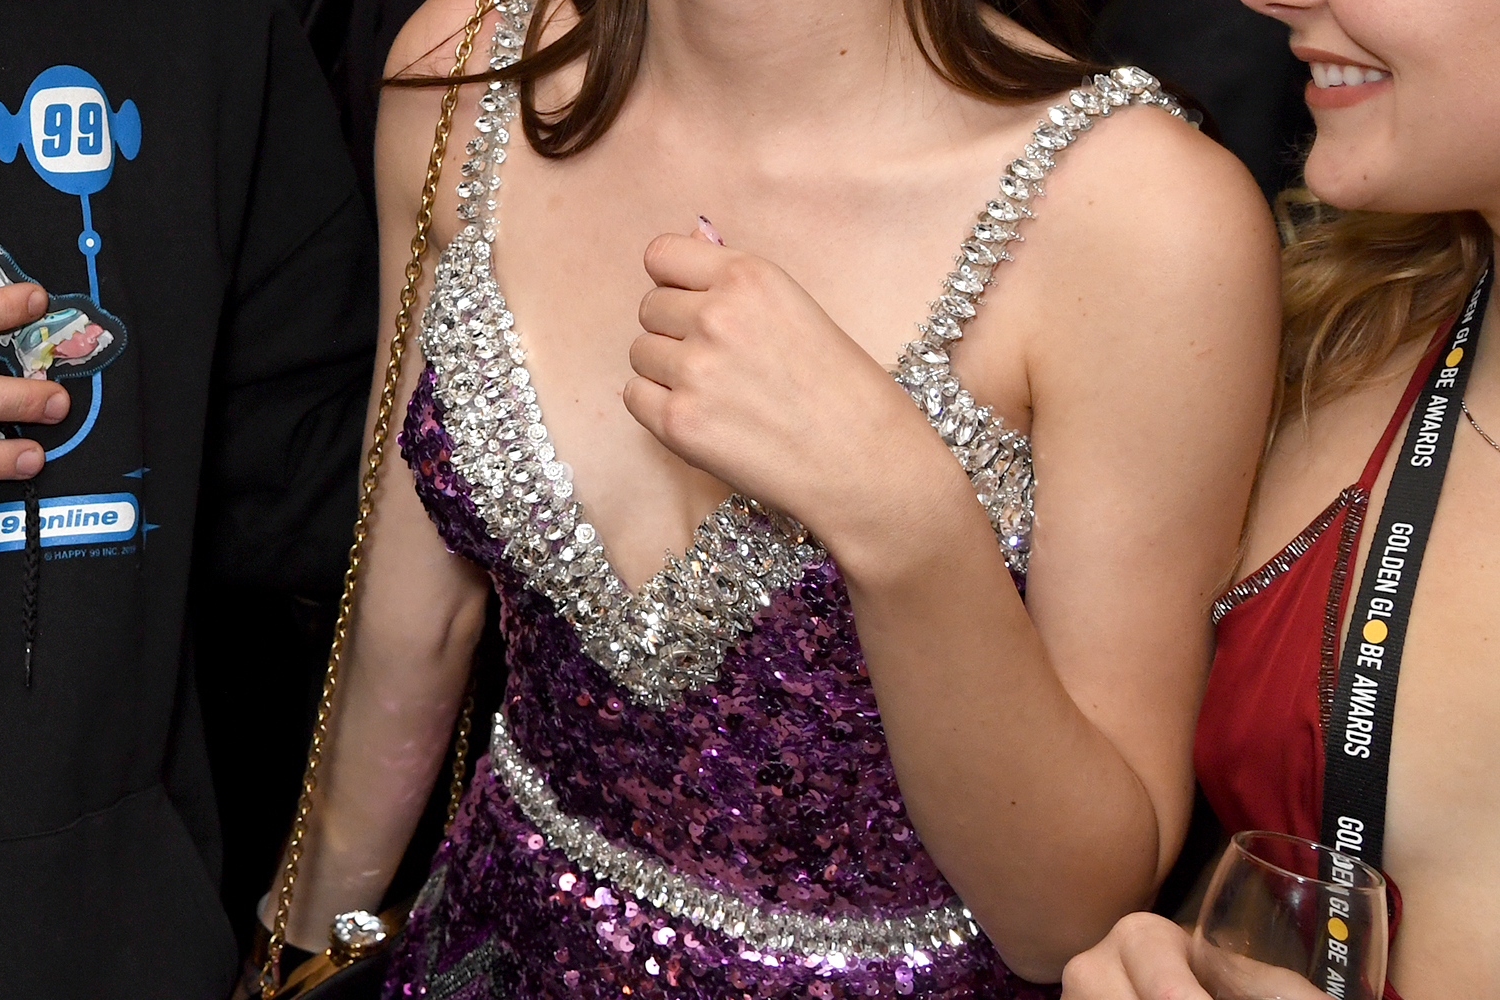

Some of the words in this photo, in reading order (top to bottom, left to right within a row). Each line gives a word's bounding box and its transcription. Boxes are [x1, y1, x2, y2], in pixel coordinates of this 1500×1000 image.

[42, 102, 103, 157] 99
[1410, 394, 1449, 468] AWARDS
[54, 549, 86, 559] HAPPY
[1374, 521, 1414, 594] GOLDEN
[1343, 673, 1379, 759] AWARDS
